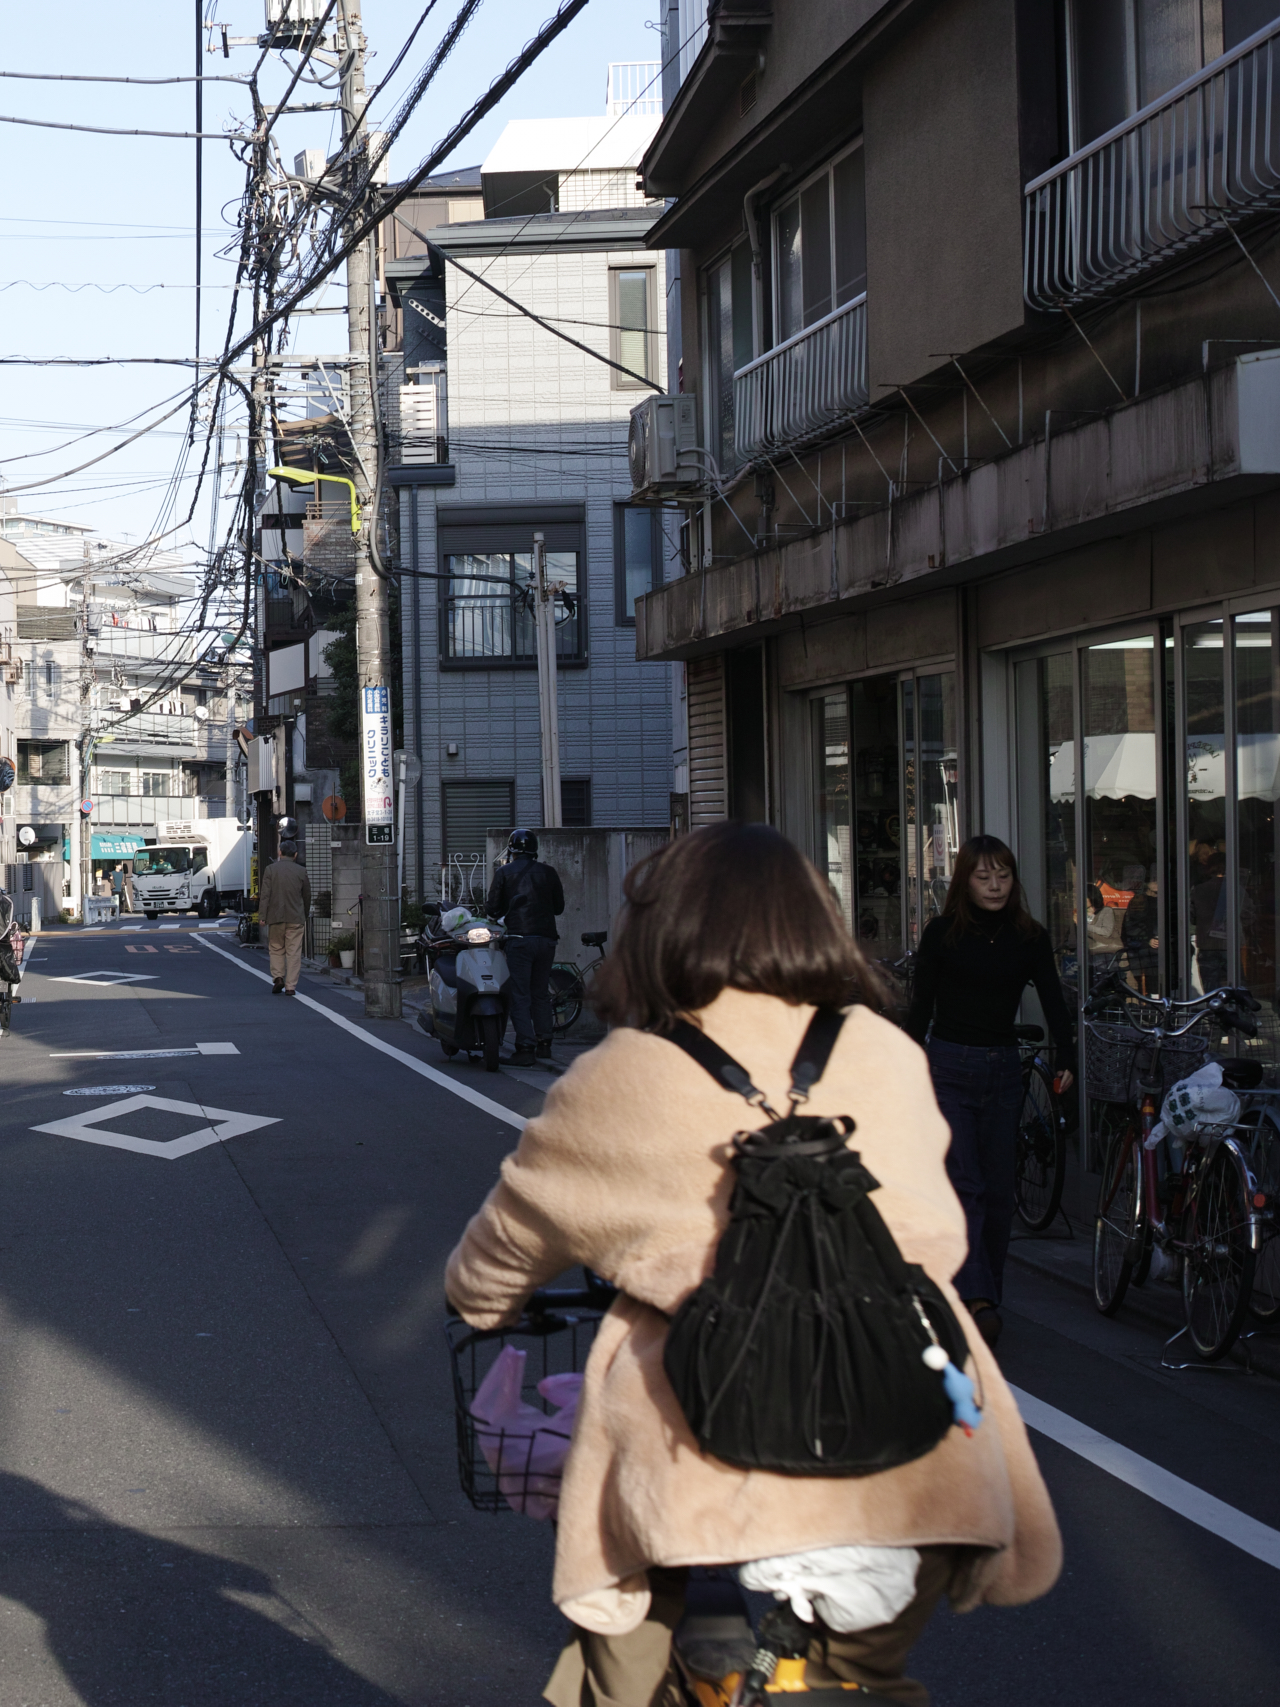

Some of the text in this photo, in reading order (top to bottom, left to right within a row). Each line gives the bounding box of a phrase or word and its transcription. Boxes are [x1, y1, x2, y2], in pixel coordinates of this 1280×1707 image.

[367, 730, 377, 778] クリニック
